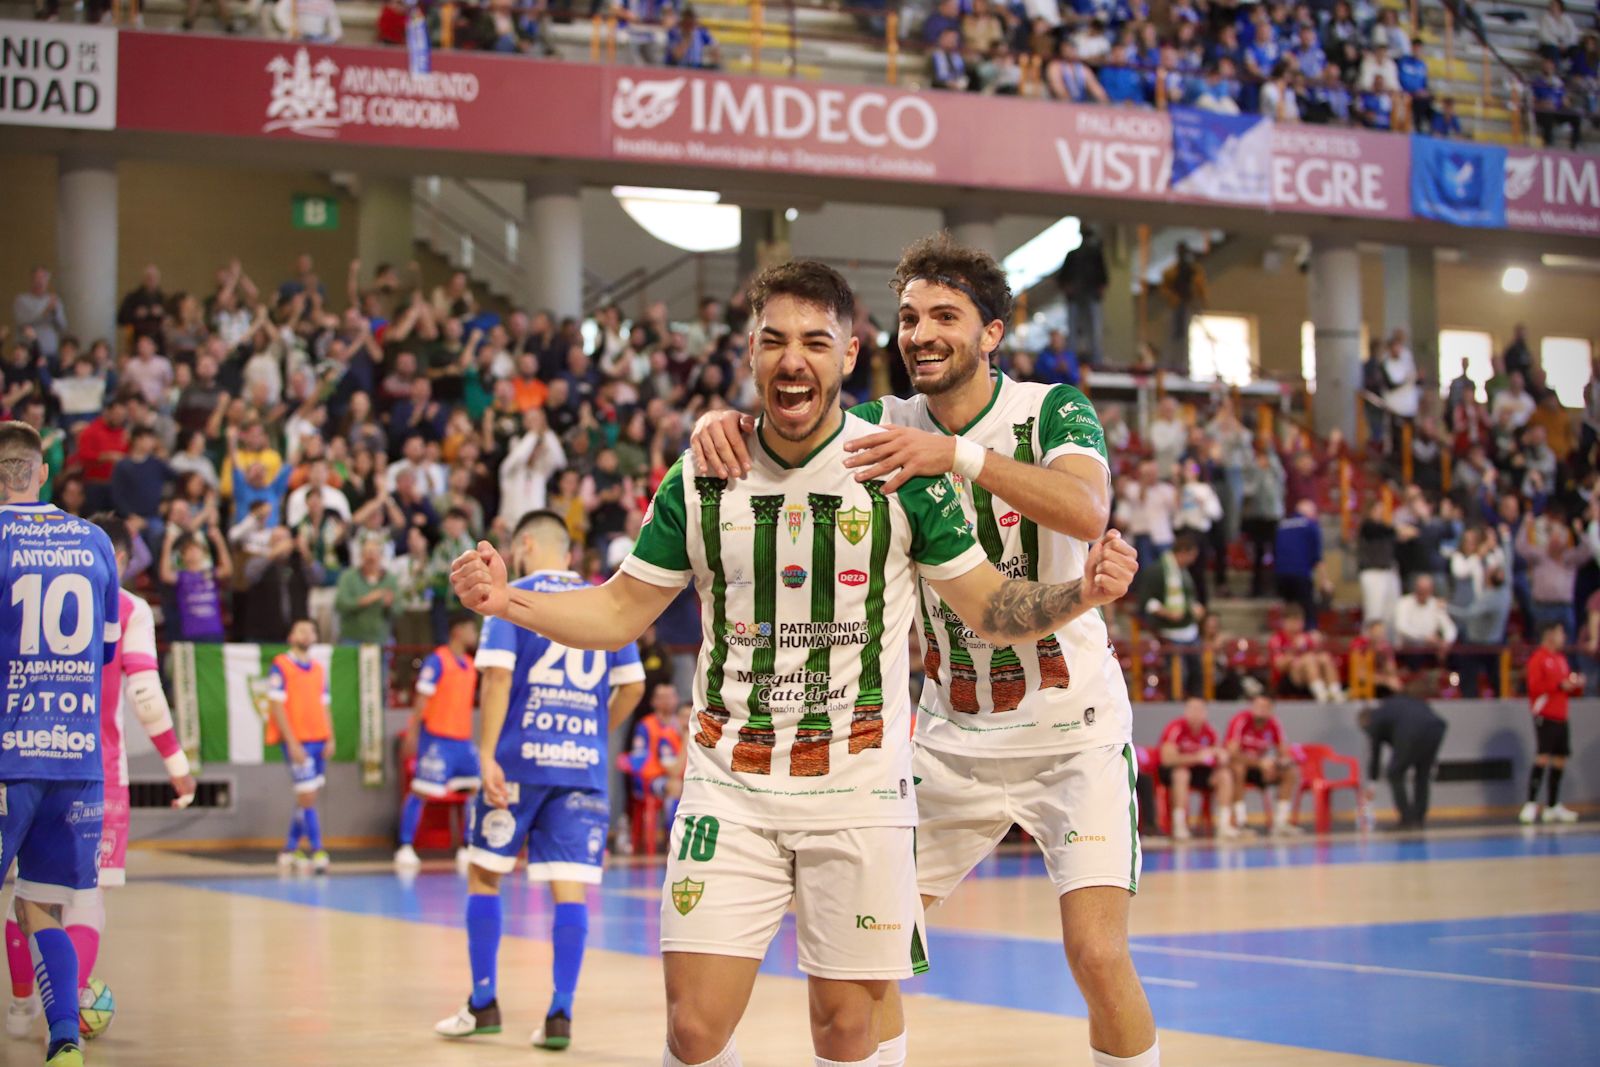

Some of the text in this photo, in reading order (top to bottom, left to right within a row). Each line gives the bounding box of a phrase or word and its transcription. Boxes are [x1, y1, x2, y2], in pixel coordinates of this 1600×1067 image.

[3, 36, 69, 70] NIO
[341, 65, 479, 102] AYUNTAMIENTO
[341, 95, 366, 124] DE
[690, 78, 938, 150] IMDECO
[1076, 112, 1163, 141] PALACIO
[303, 203, 327, 224] B
[11, 547, 94, 568] ANTOÑITO
[11, 573, 94, 656] 10
[780, 621, 860, 635] PATRIMONIO
[779, 633, 870, 648] HUMANIDAD
[528, 639, 607, 690] 20
[7, 692, 96, 714] FOTON
[758, 685, 847, 702] Catedral
[758, 702, 795, 714] Corazón
[799, 702, 809, 713] de
[521, 711, 598, 736] FOTON
[678, 815, 720, 862] 10
